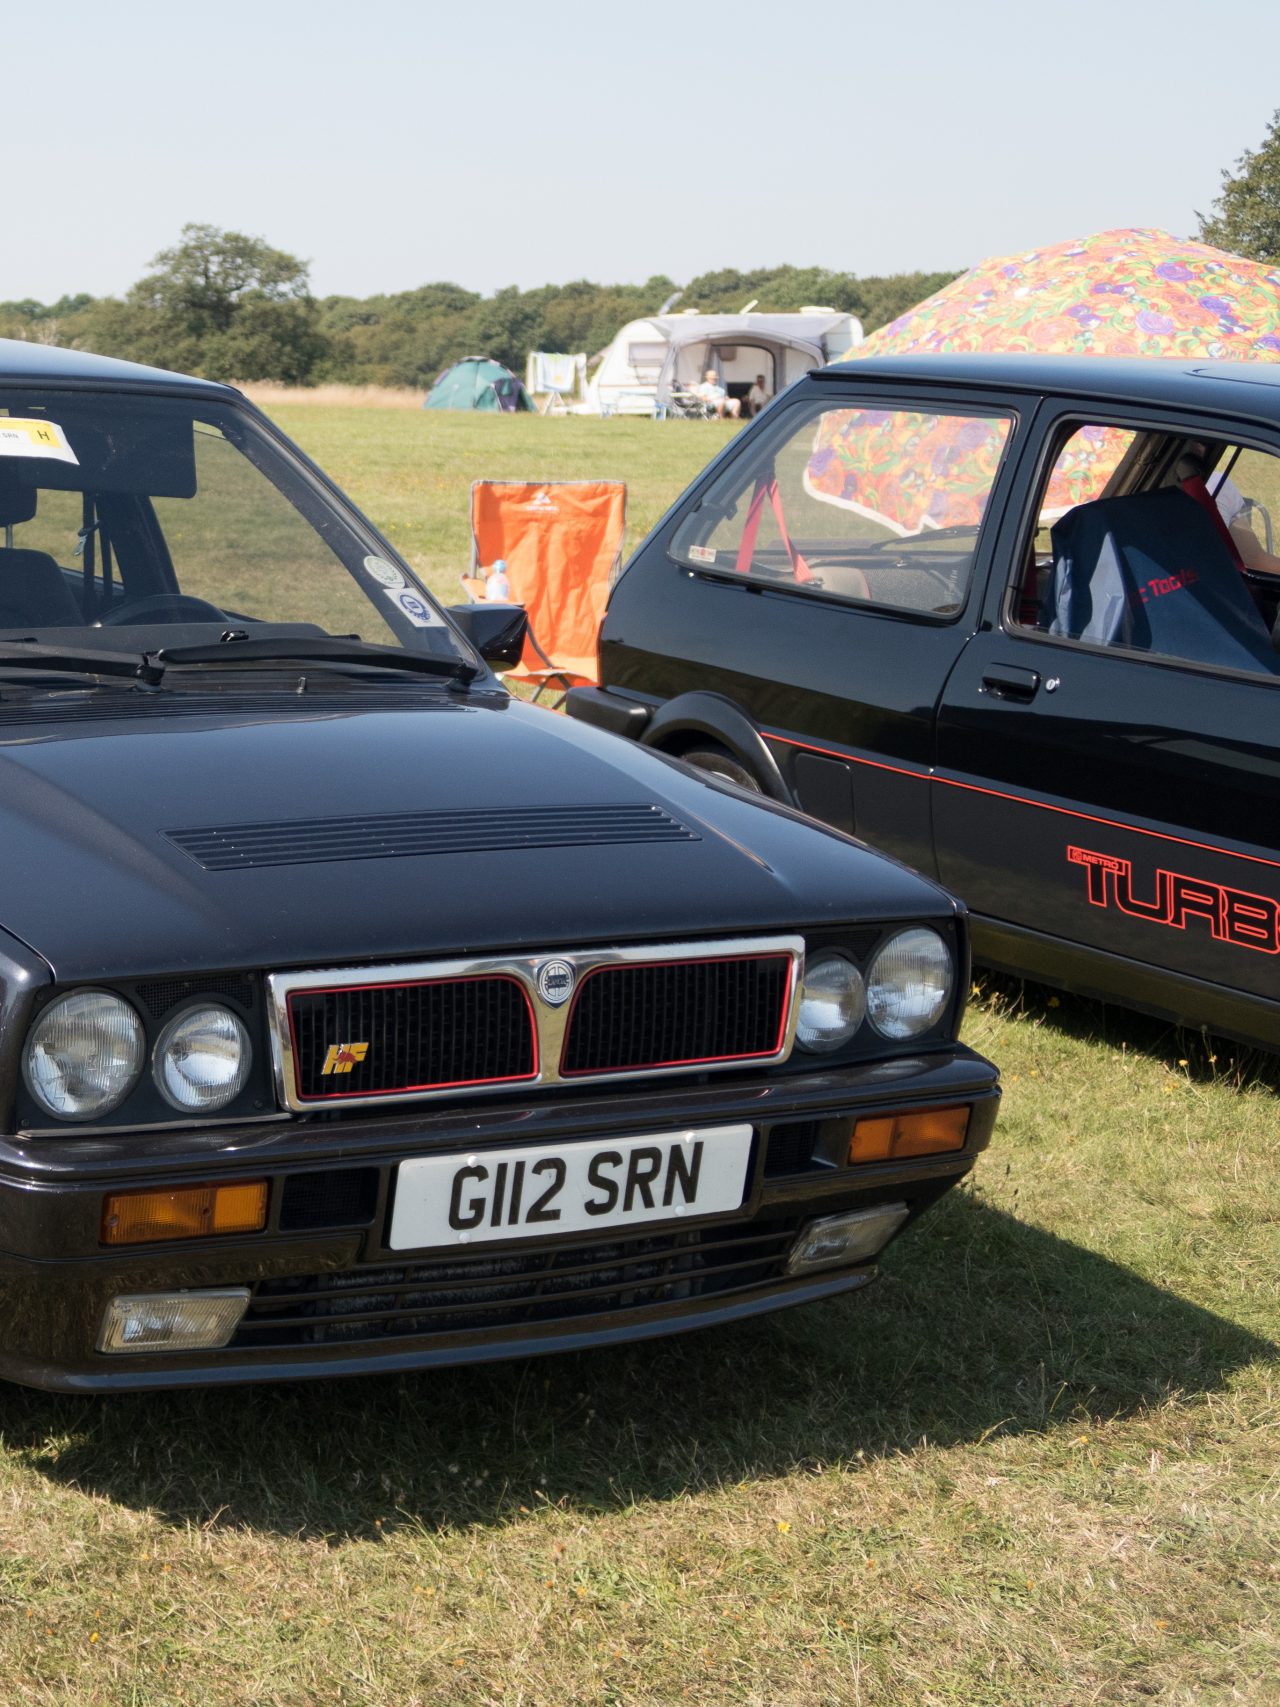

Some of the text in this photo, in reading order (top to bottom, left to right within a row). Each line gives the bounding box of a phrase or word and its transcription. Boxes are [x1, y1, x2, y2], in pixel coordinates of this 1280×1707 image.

[37, 430, 50, 441] H
[1083, 853, 1119, 870] METRO
[1067, 845, 1280, 955] TURB
[321, 1042, 369, 1075] HF
[448, 1141, 705, 1231] G112 SRN
